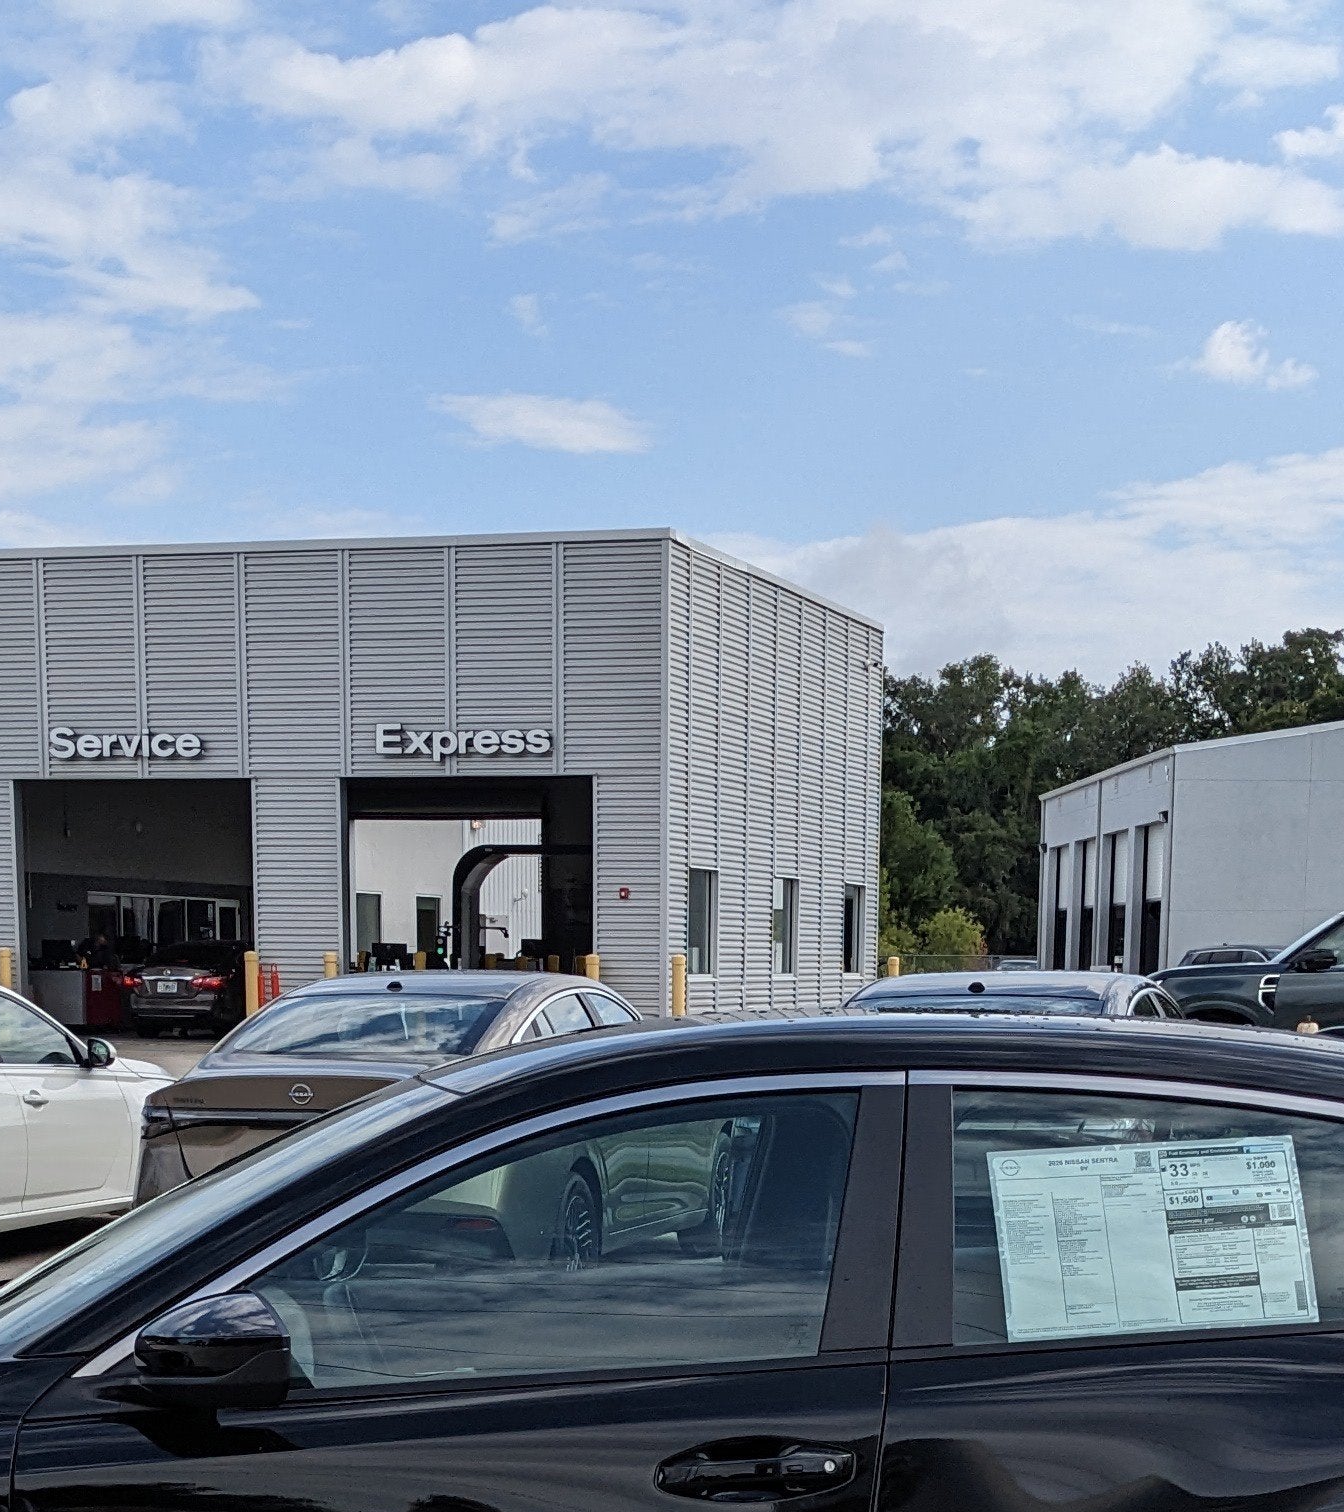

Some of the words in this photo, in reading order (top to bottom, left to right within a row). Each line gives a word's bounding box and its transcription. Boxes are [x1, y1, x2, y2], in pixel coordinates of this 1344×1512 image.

[48, 727, 202, 759] Service
[375, 723, 552, 762] Express
[1169, 1163, 1189, 1177] 33
[1169, 1195, 1199, 1205] $1,500
